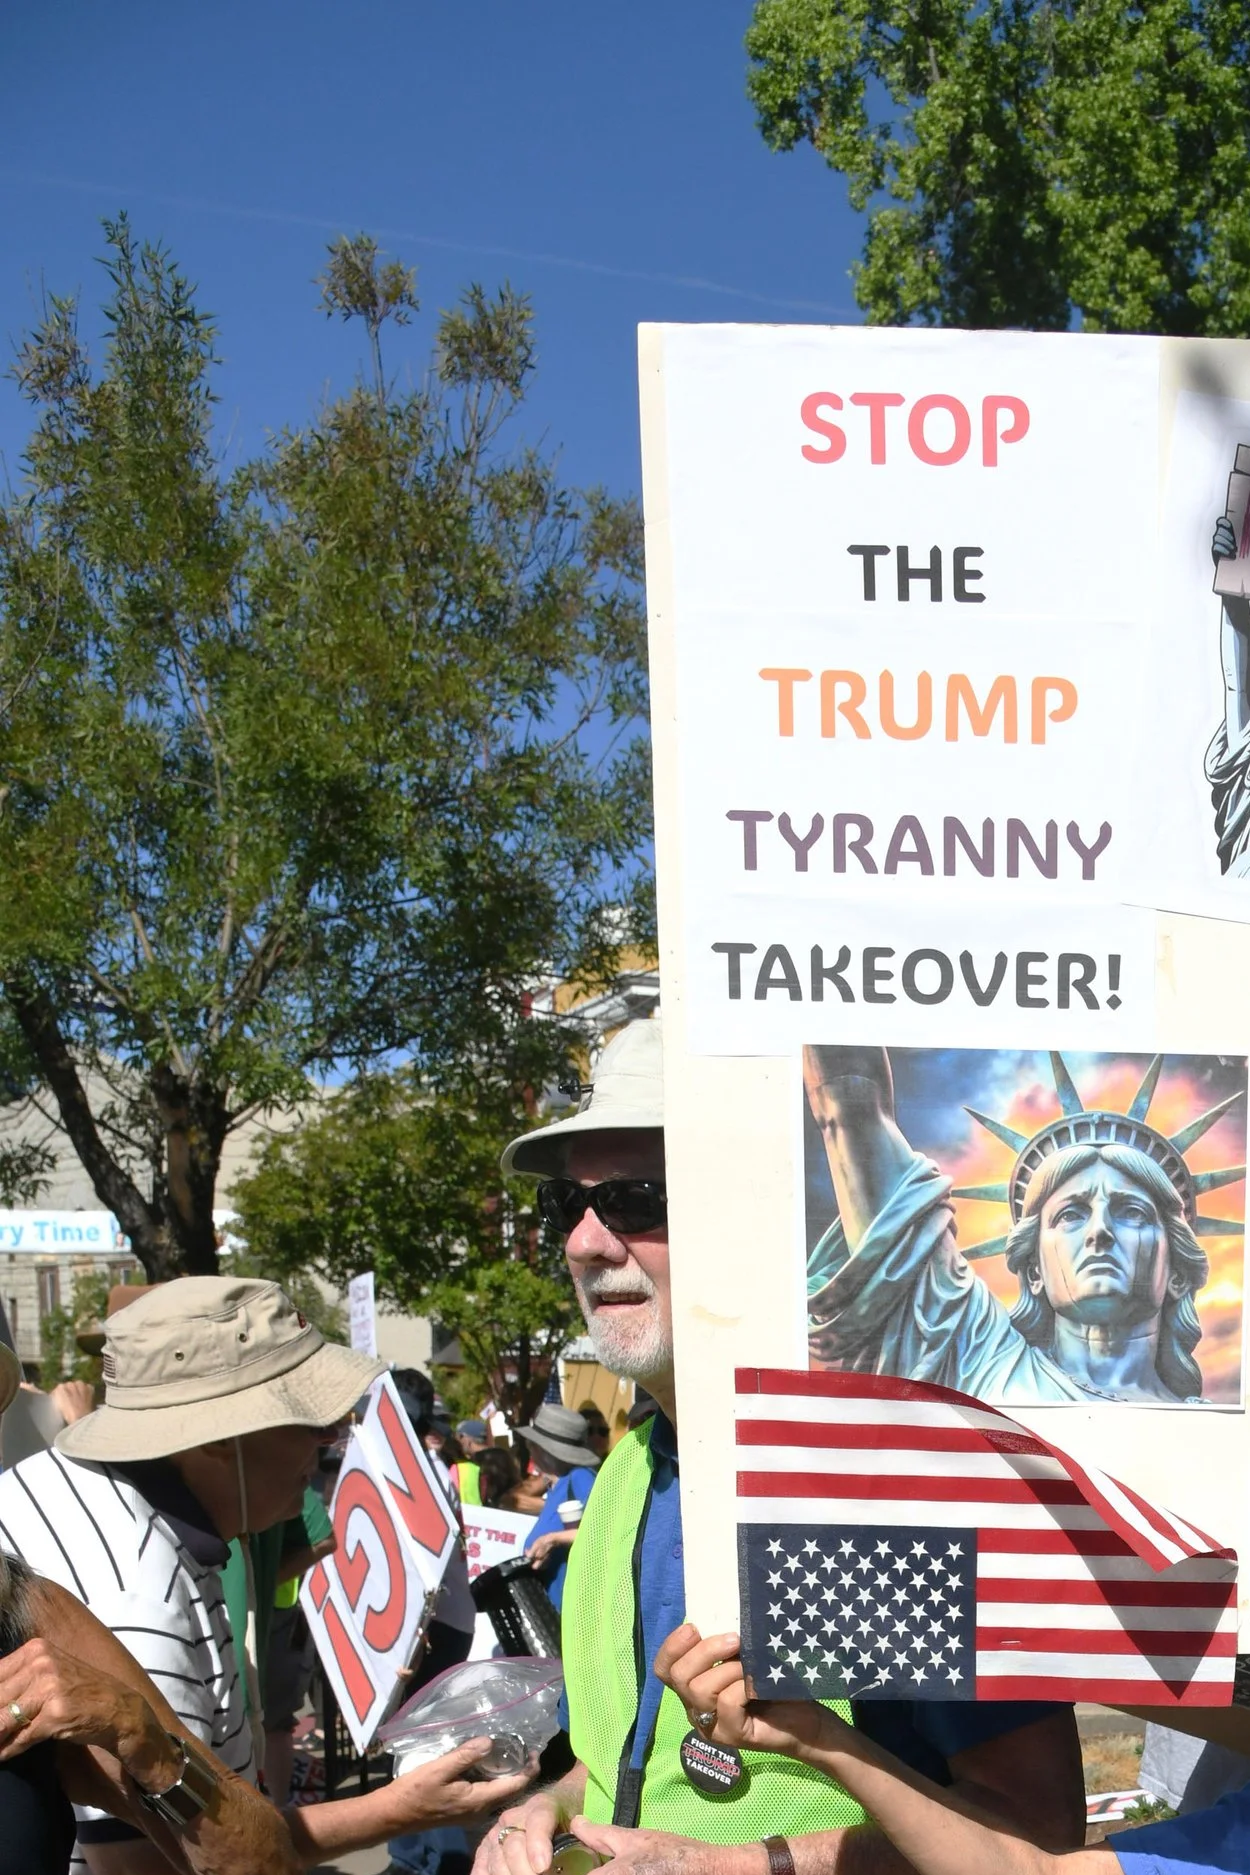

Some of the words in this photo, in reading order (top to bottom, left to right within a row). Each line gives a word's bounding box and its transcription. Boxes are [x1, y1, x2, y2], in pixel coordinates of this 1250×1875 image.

[800, 391, 1031, 468] STOP
[846, 544, 986, 604] THE
[759, 668, 1079, 746] TRUMP
[725, 809, 1114, 882] TYRANNY
[711, 942, 1124, 1011] TAKEOVER!
[33, 1221, 99, 1241] Time
[485, 1528, 517, 1545] THE
[686, 1757, 731, 1785] TAKEOVER
[690, 1737, 718, 1755] FIGHT
[718, 1750, 736, 1764] THE
